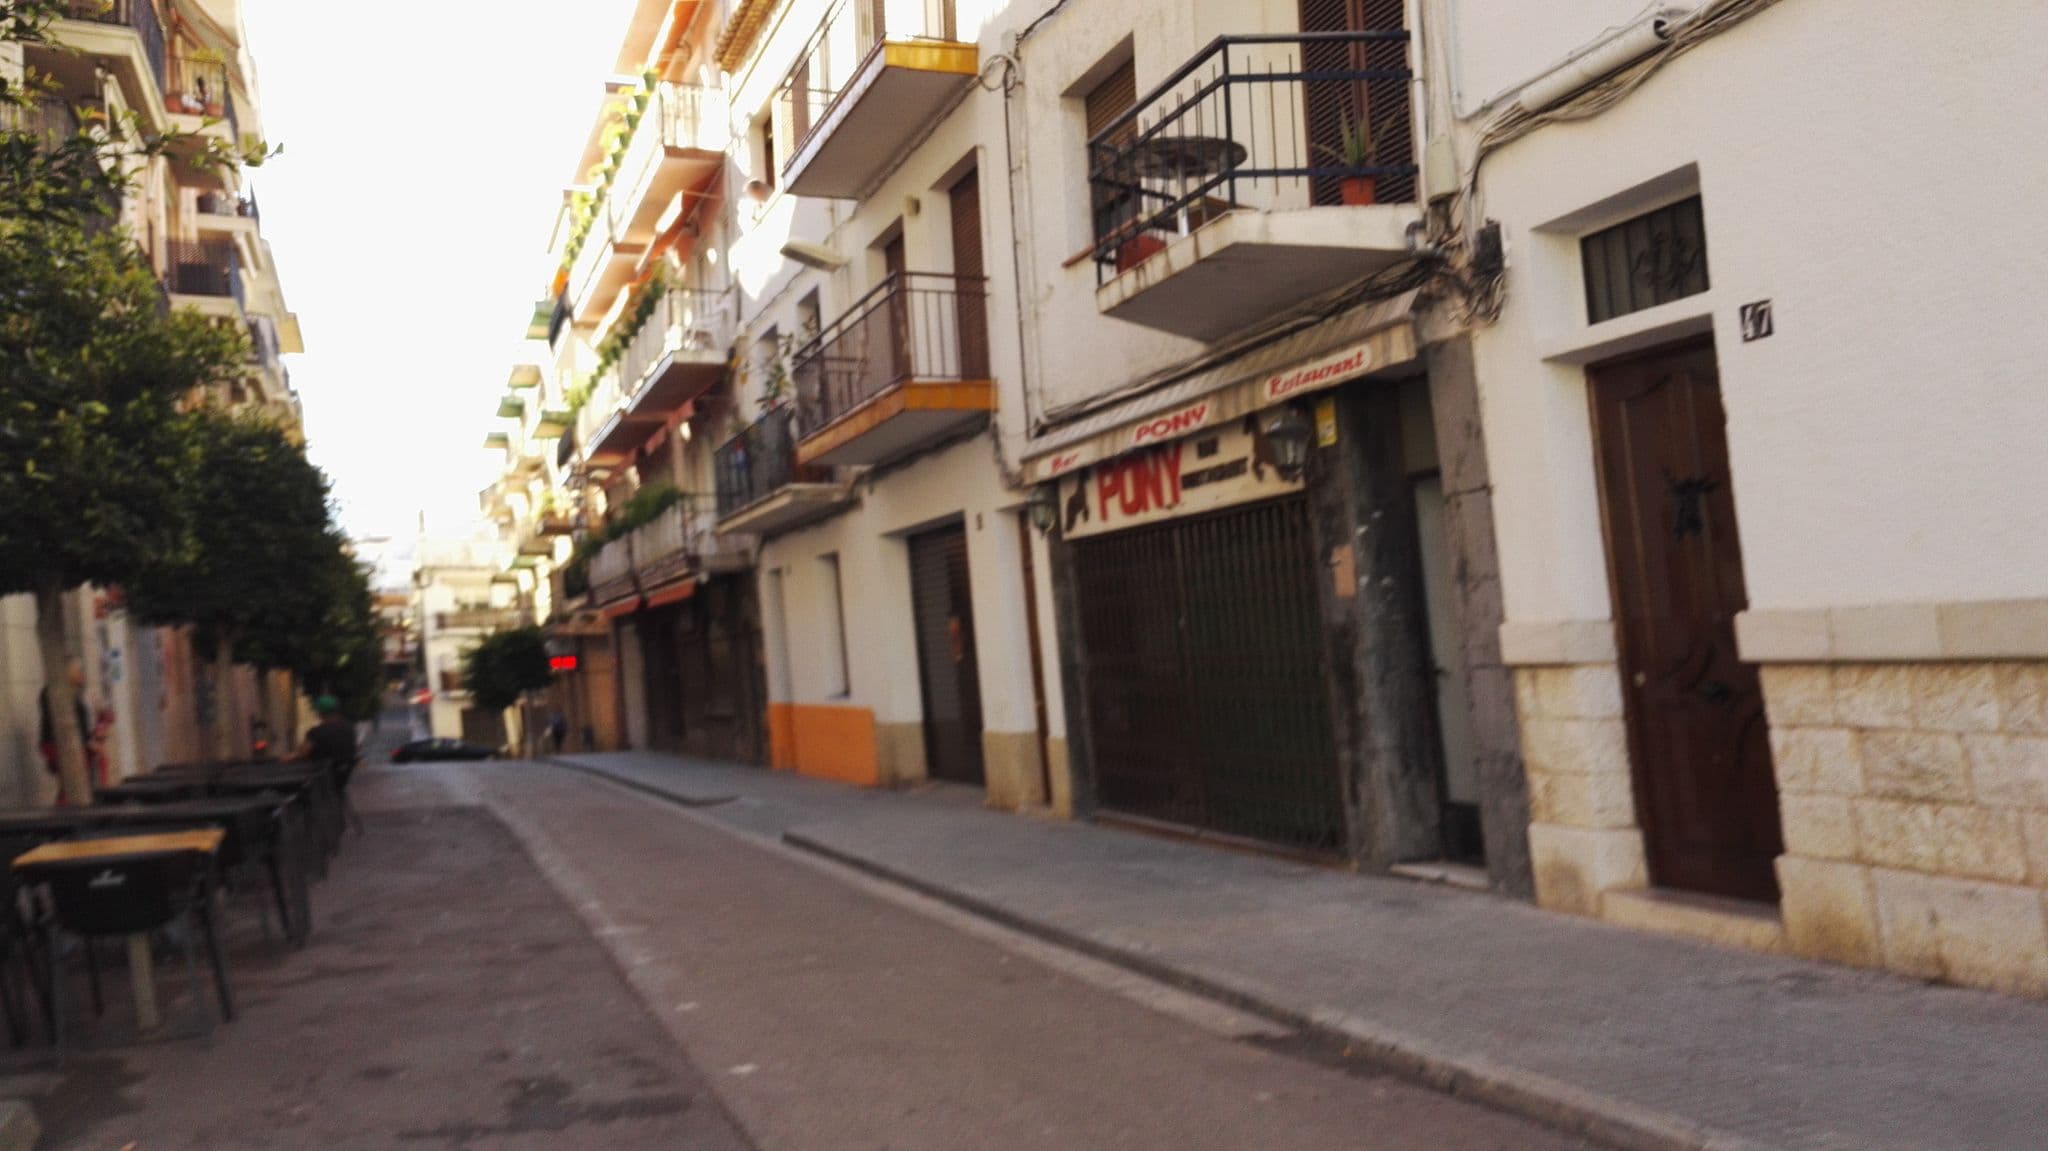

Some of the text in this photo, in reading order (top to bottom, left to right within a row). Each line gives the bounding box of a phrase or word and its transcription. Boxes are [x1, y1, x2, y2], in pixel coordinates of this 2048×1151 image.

[1135, 404, 1206, 442] PONY
[1268, 350, 1364, 397] Restaurant
[1097, 443, 1183, 522] PONY
